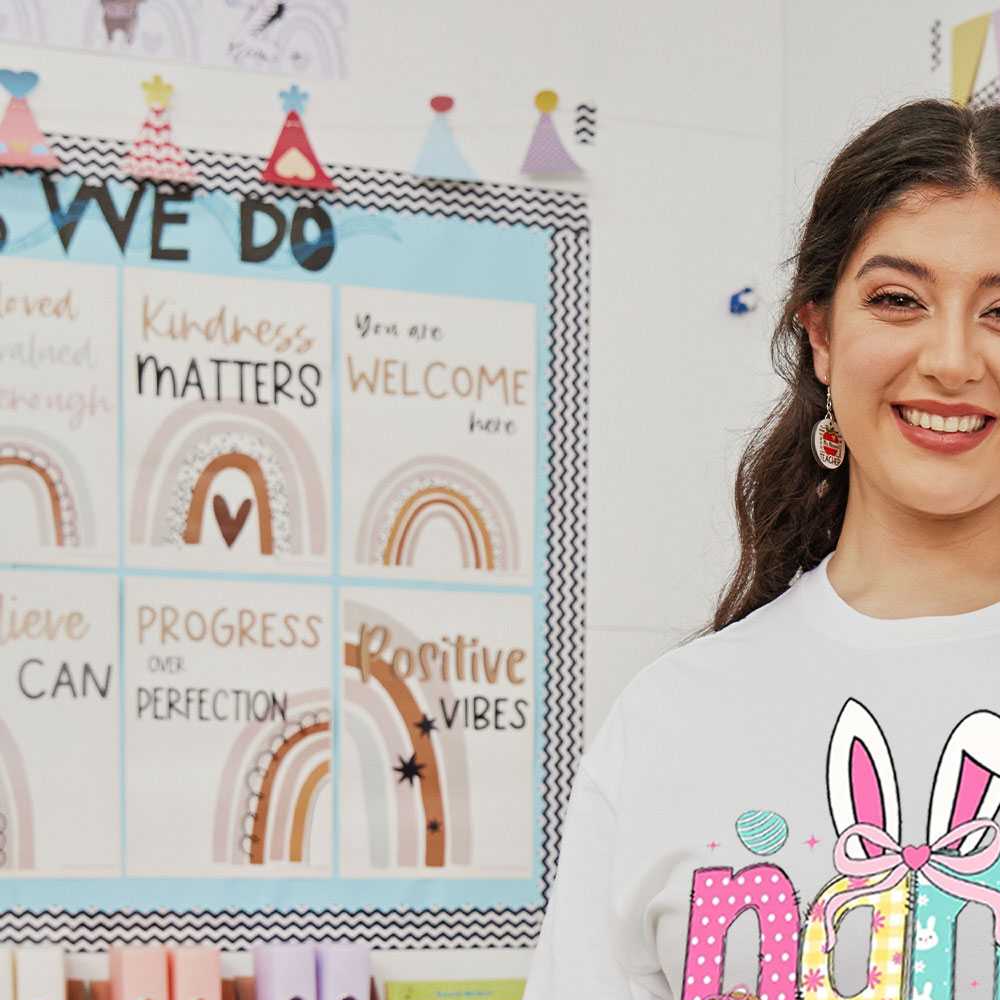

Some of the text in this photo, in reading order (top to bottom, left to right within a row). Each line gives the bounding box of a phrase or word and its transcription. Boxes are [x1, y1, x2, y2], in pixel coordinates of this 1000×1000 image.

[40, 176, 191, 263] WE
[240, 198, 337, 272] DO
[140, 295, 316, 355] Kindness
[354, 312, 400, 342] You
[136, 354, 324, 408] MATTERS
[346, 354, 530, 407] WELCOME
[469, 411, 518, 436] here
[137, 604, 324, 650] PROGRESS
[147, 655, 187, 677] OVER
[356, 622, 529, 686] Positive
[18, 657, 112, 700] CAN
[135, 686, 289, 724] PERFECTION
[439, 696, 531, 732] VIBES
